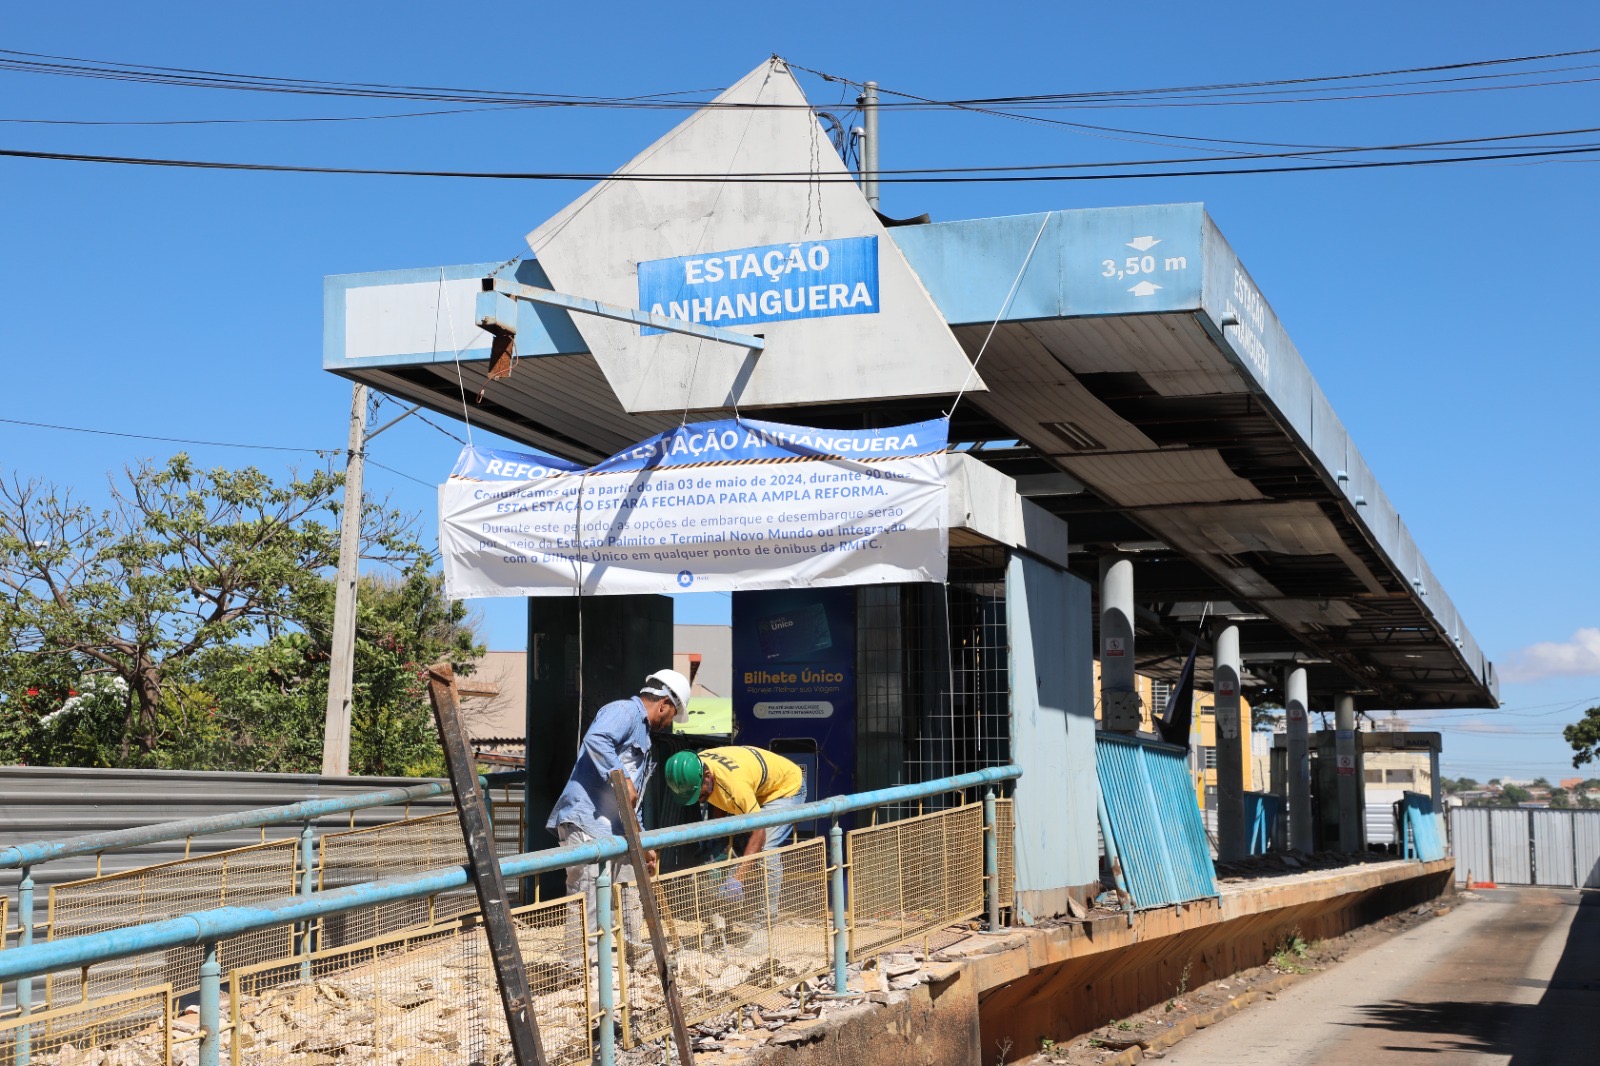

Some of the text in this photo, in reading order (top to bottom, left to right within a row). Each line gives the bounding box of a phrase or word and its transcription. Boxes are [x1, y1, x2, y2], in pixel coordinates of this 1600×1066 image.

[685, 243, 830, 285] ESTAÇÃO
[1102, 255, 1187, 280] 3,50 m
[1233, 268, 1264, 333] ESTAÇÃO
[485, 459, 570, 479] REFOR
[632, 432, 738, 458] ESTAÇÃO
[743, 431, 918, 451] ANHANGUERA
[588, 486, 595, 495] a
[598, 484, 634, 497] partir
[637, 481, 652, 493] do
[656, 480, 675, 491] dia
[678, 478, 694, 490] 03
[697, 478, 712, 489] de
[715, 476, 747, 488] maio
[750, 475, 766, 487] de
[770, 474, 806, 485] 2024,
[809, 471, 862, 484] durante
[865, 469, 881, 480] 90
[497, 485, 888, 513] ESTA ESTAÇÃO ESTARÁ FECHADA PARA AMPLA REFORMA.
[482, 506, 903, 535] Durante este peíodo, as opções de embarque e desembarque serão
[538, 538, 553, 549] da
[556, 537, 604, 549] Estação
[608, 535, 656, 547] Palmito
[659, 536, 667, 544] e
[670, 531, 726, 544] Terminal
[729, 531, 764, 542] Novo
[768, 527, 813, 540] Mundo
[817, 528, 834, 537] ou
[837, 522, 907, 538] integração
[503, 539, 882, 564] com o Bilhete Único em qualquer ponto de ônibus da RMTC.
[744, 667, 844, 684] Bilhete Único
